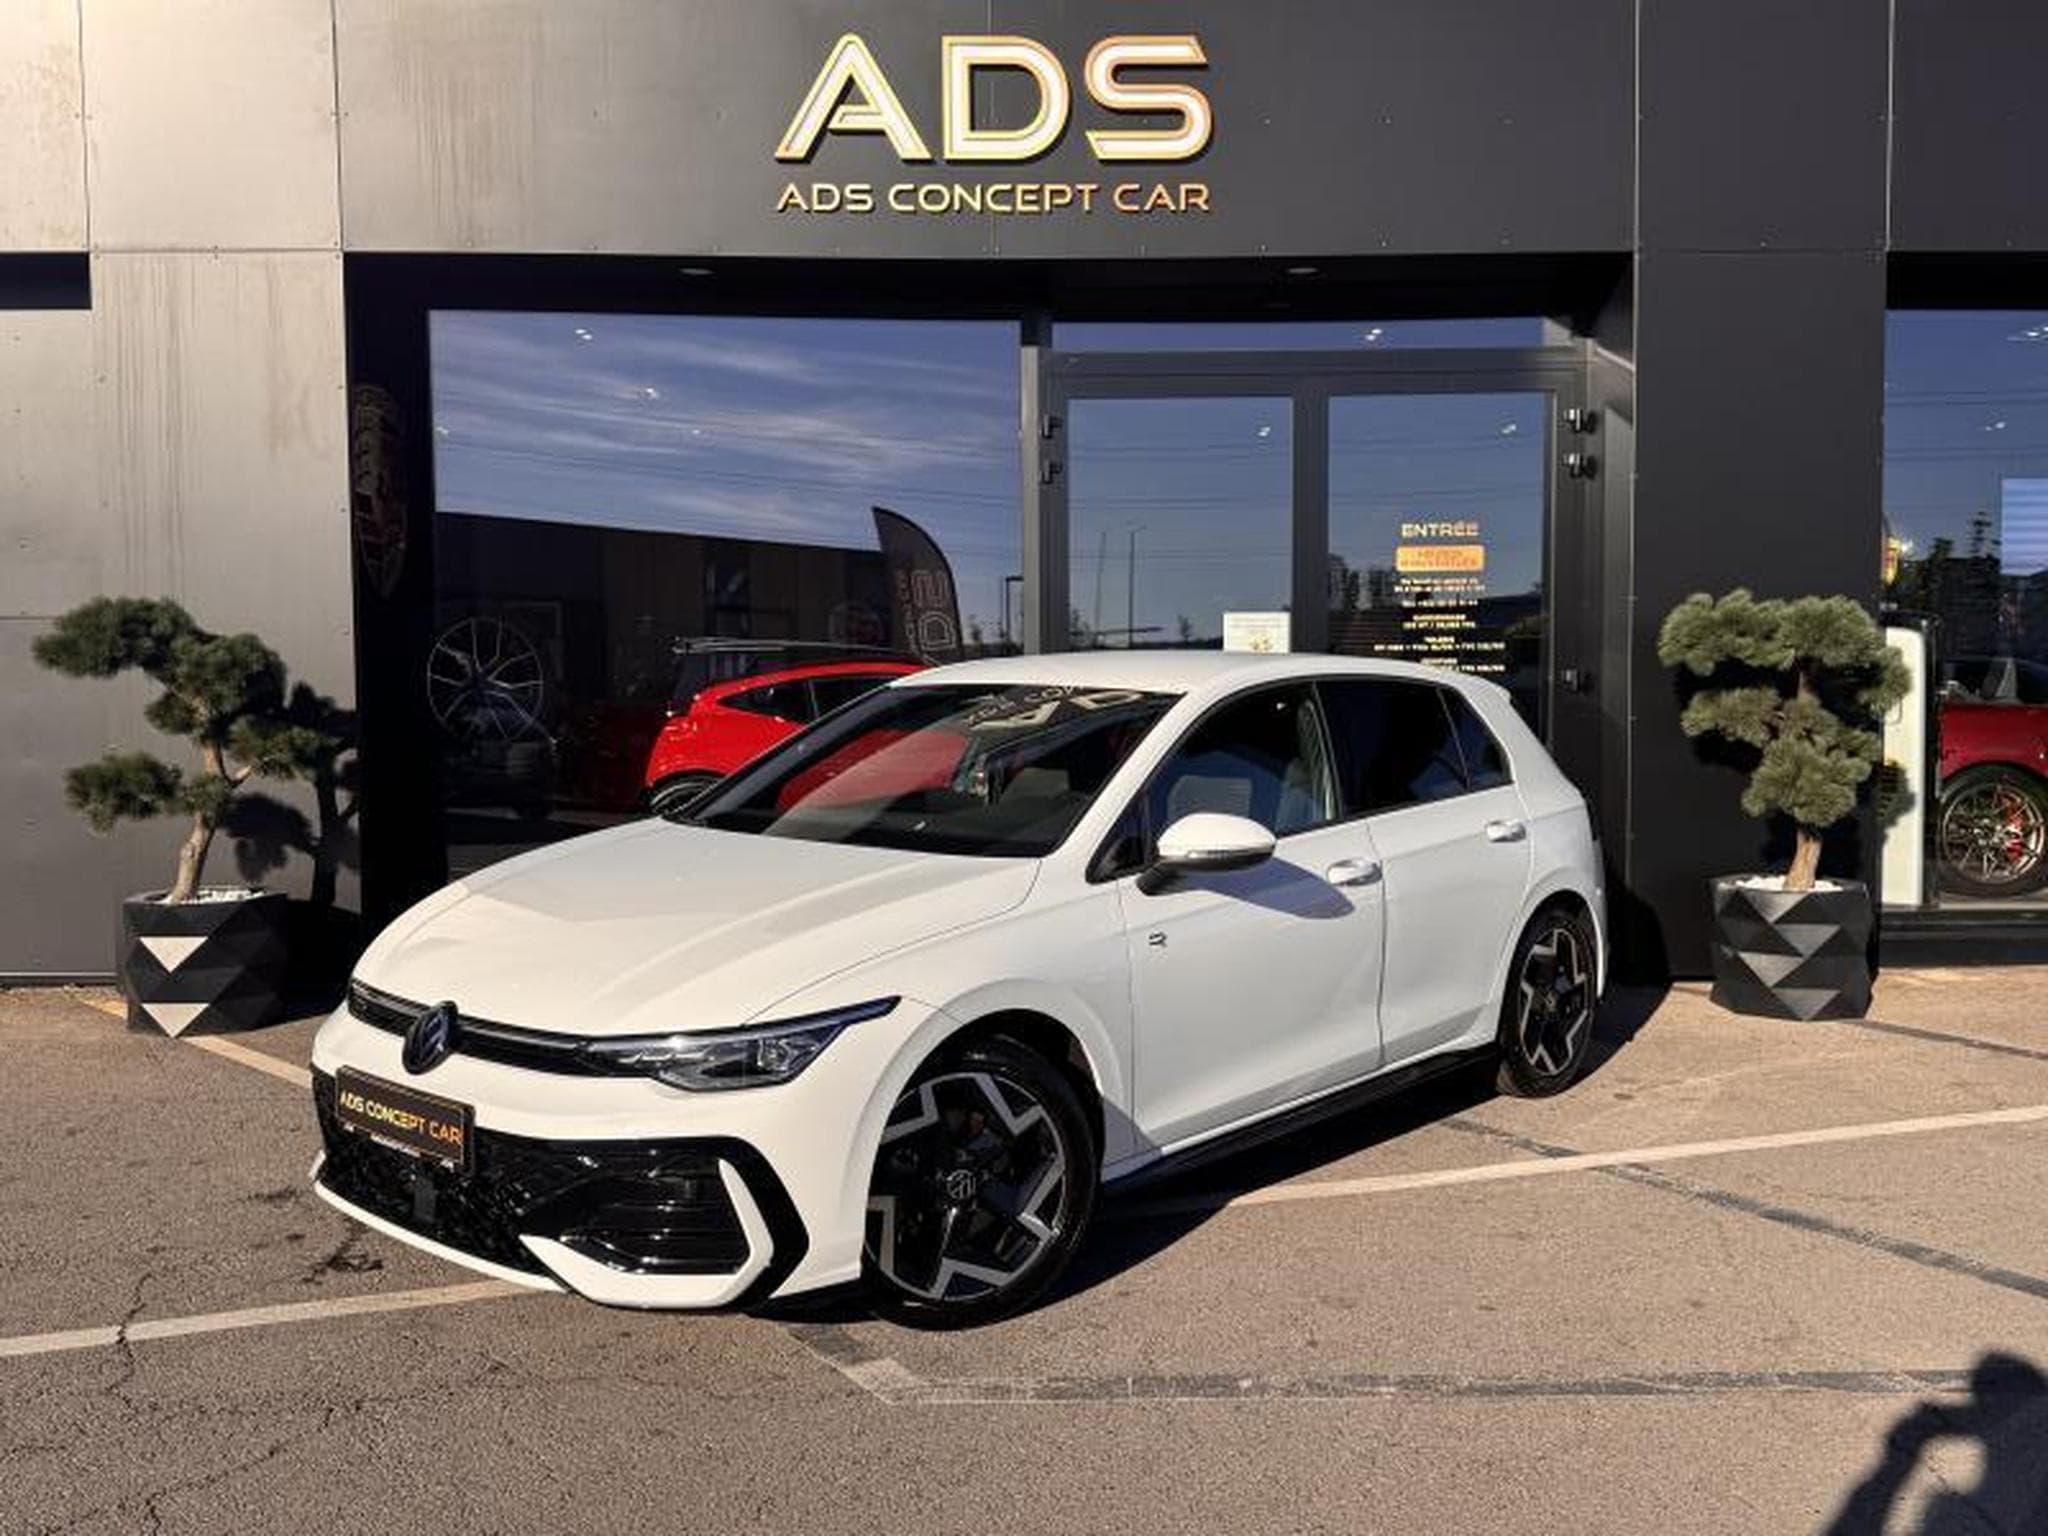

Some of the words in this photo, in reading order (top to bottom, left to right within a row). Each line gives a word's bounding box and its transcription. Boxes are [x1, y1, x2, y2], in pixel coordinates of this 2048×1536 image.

[774, 33, 1213, 162] ADS
[777, 184, 873, 212] ADS
[888, 184, 1098, 213] CONCEPT
[1112, 184, 1210, 212] CAR
[1401, 520, 1480, 538] ENTRÉE
[339, 1090, 364, 1113] ADS
[365, 1099, 425, 1135] CONCEPT
[429, 1119, 463, 1145] CAR
